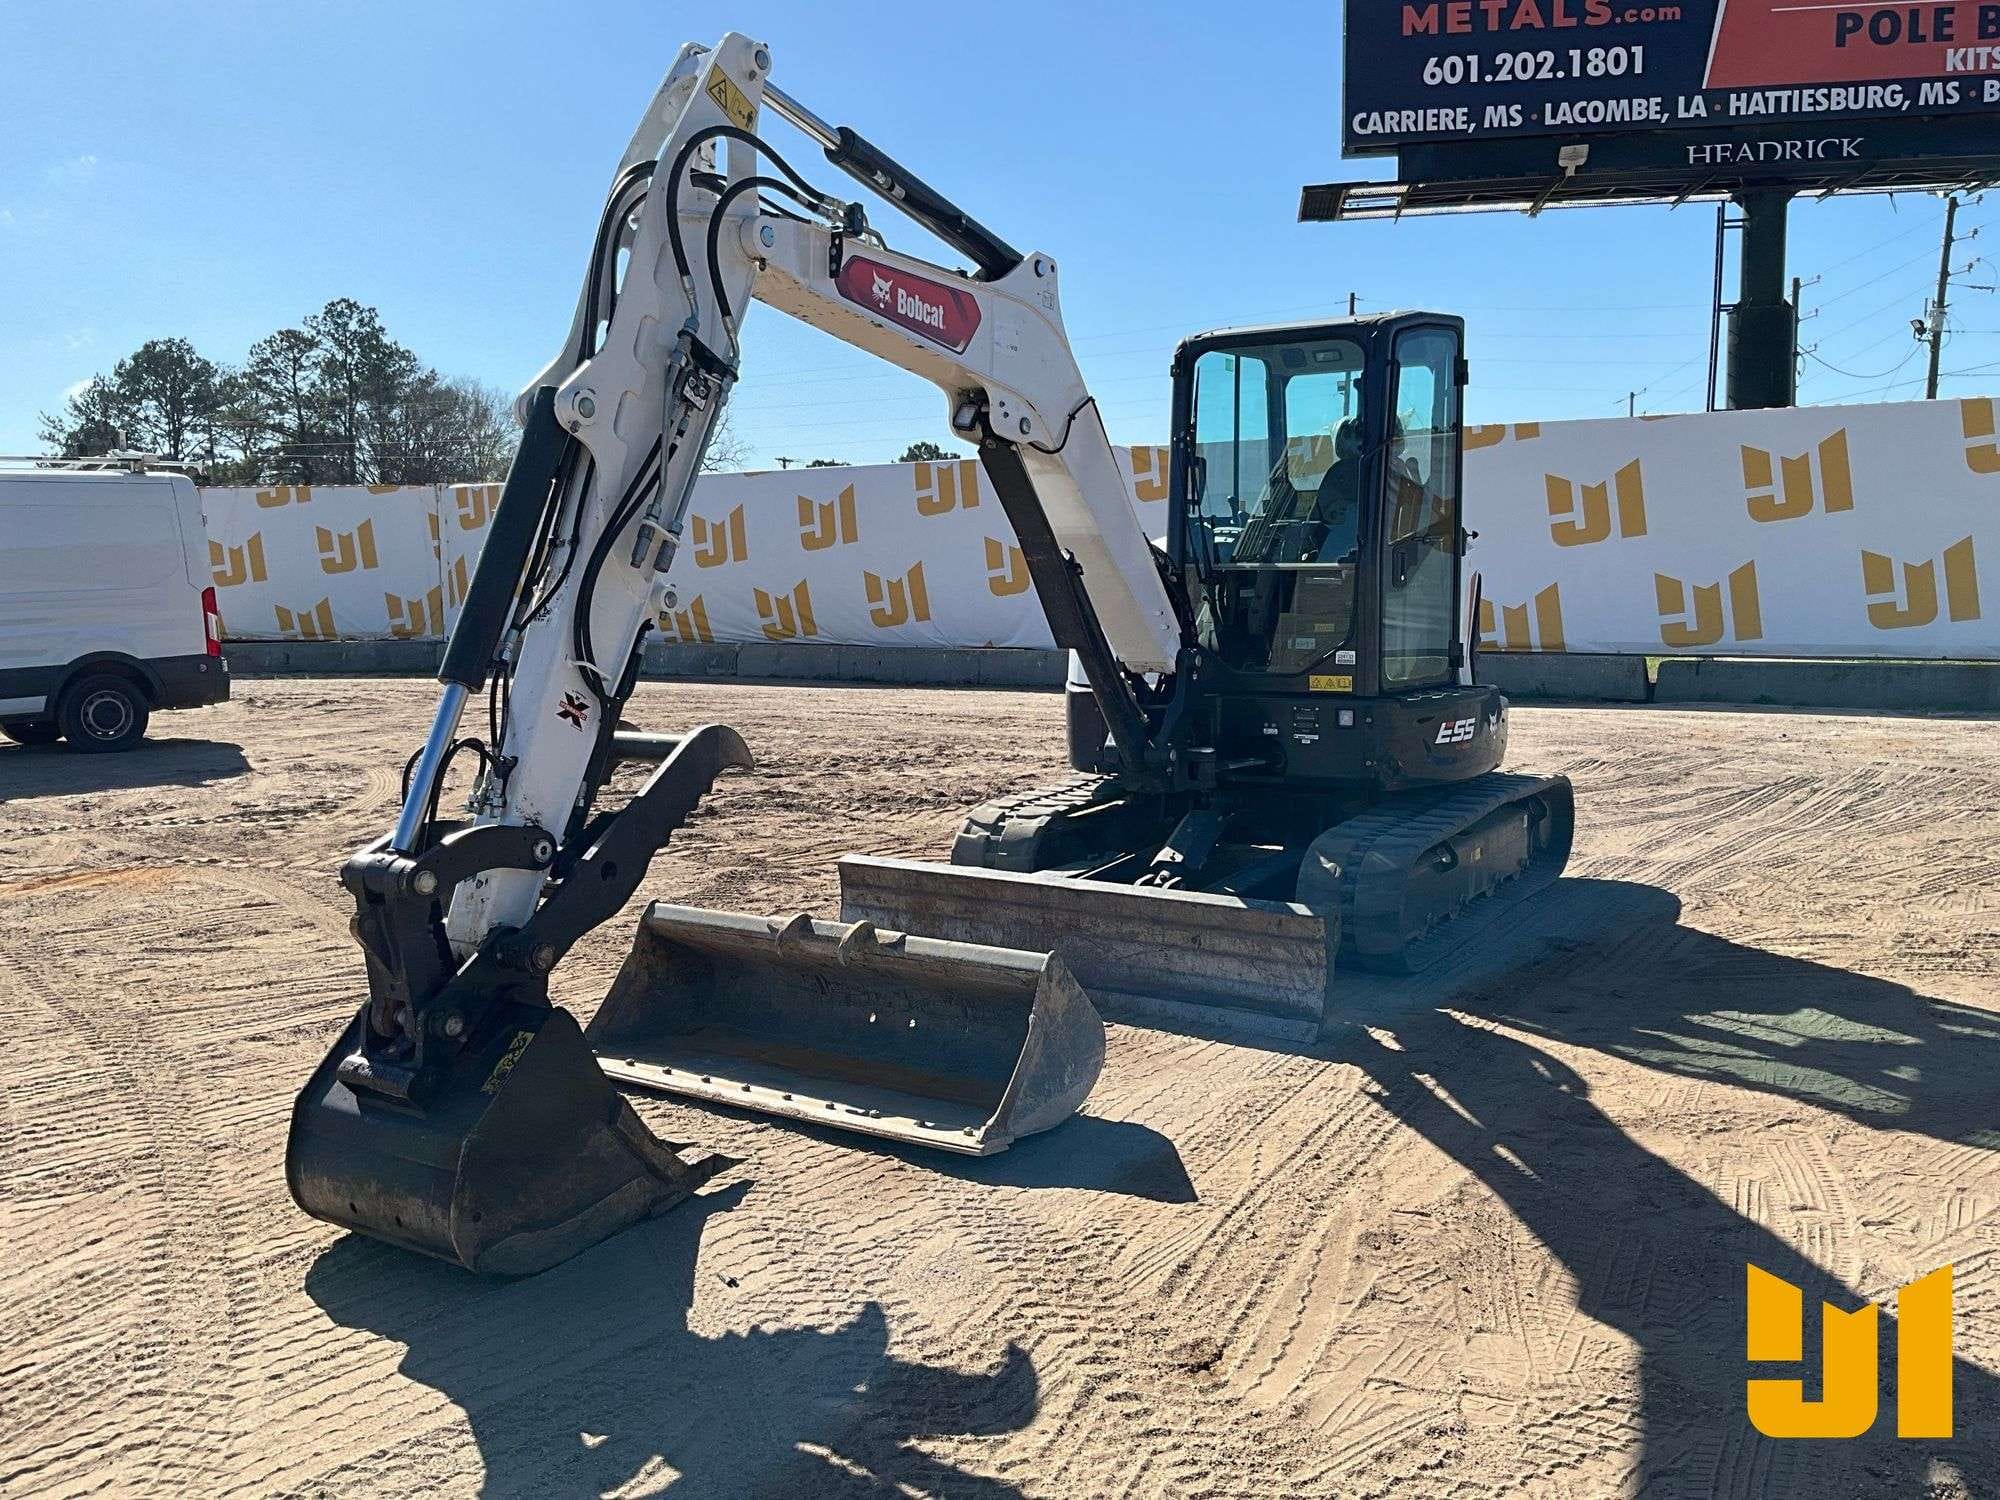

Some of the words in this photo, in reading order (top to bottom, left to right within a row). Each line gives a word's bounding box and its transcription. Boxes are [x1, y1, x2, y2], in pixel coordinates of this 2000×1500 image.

[1834, 7, 1956, 48] POLE
[1422, 45, 1644, 86] 601.202.1801
[1352, 107, 1477, 135] CARRIERE,
[1483, 104, 1523, 128] MS
[1544, 97, 1669, 125] LACOMBE,
[1677, 95, 1708, 119] LA
[1729, 84, 1911, 116] HATTIESBURG,
[1918, 81, 1960, 106] MS
[1686, 137, 1865, 164] HEADRICK
[897, 287, 944, 330] Bobcat
